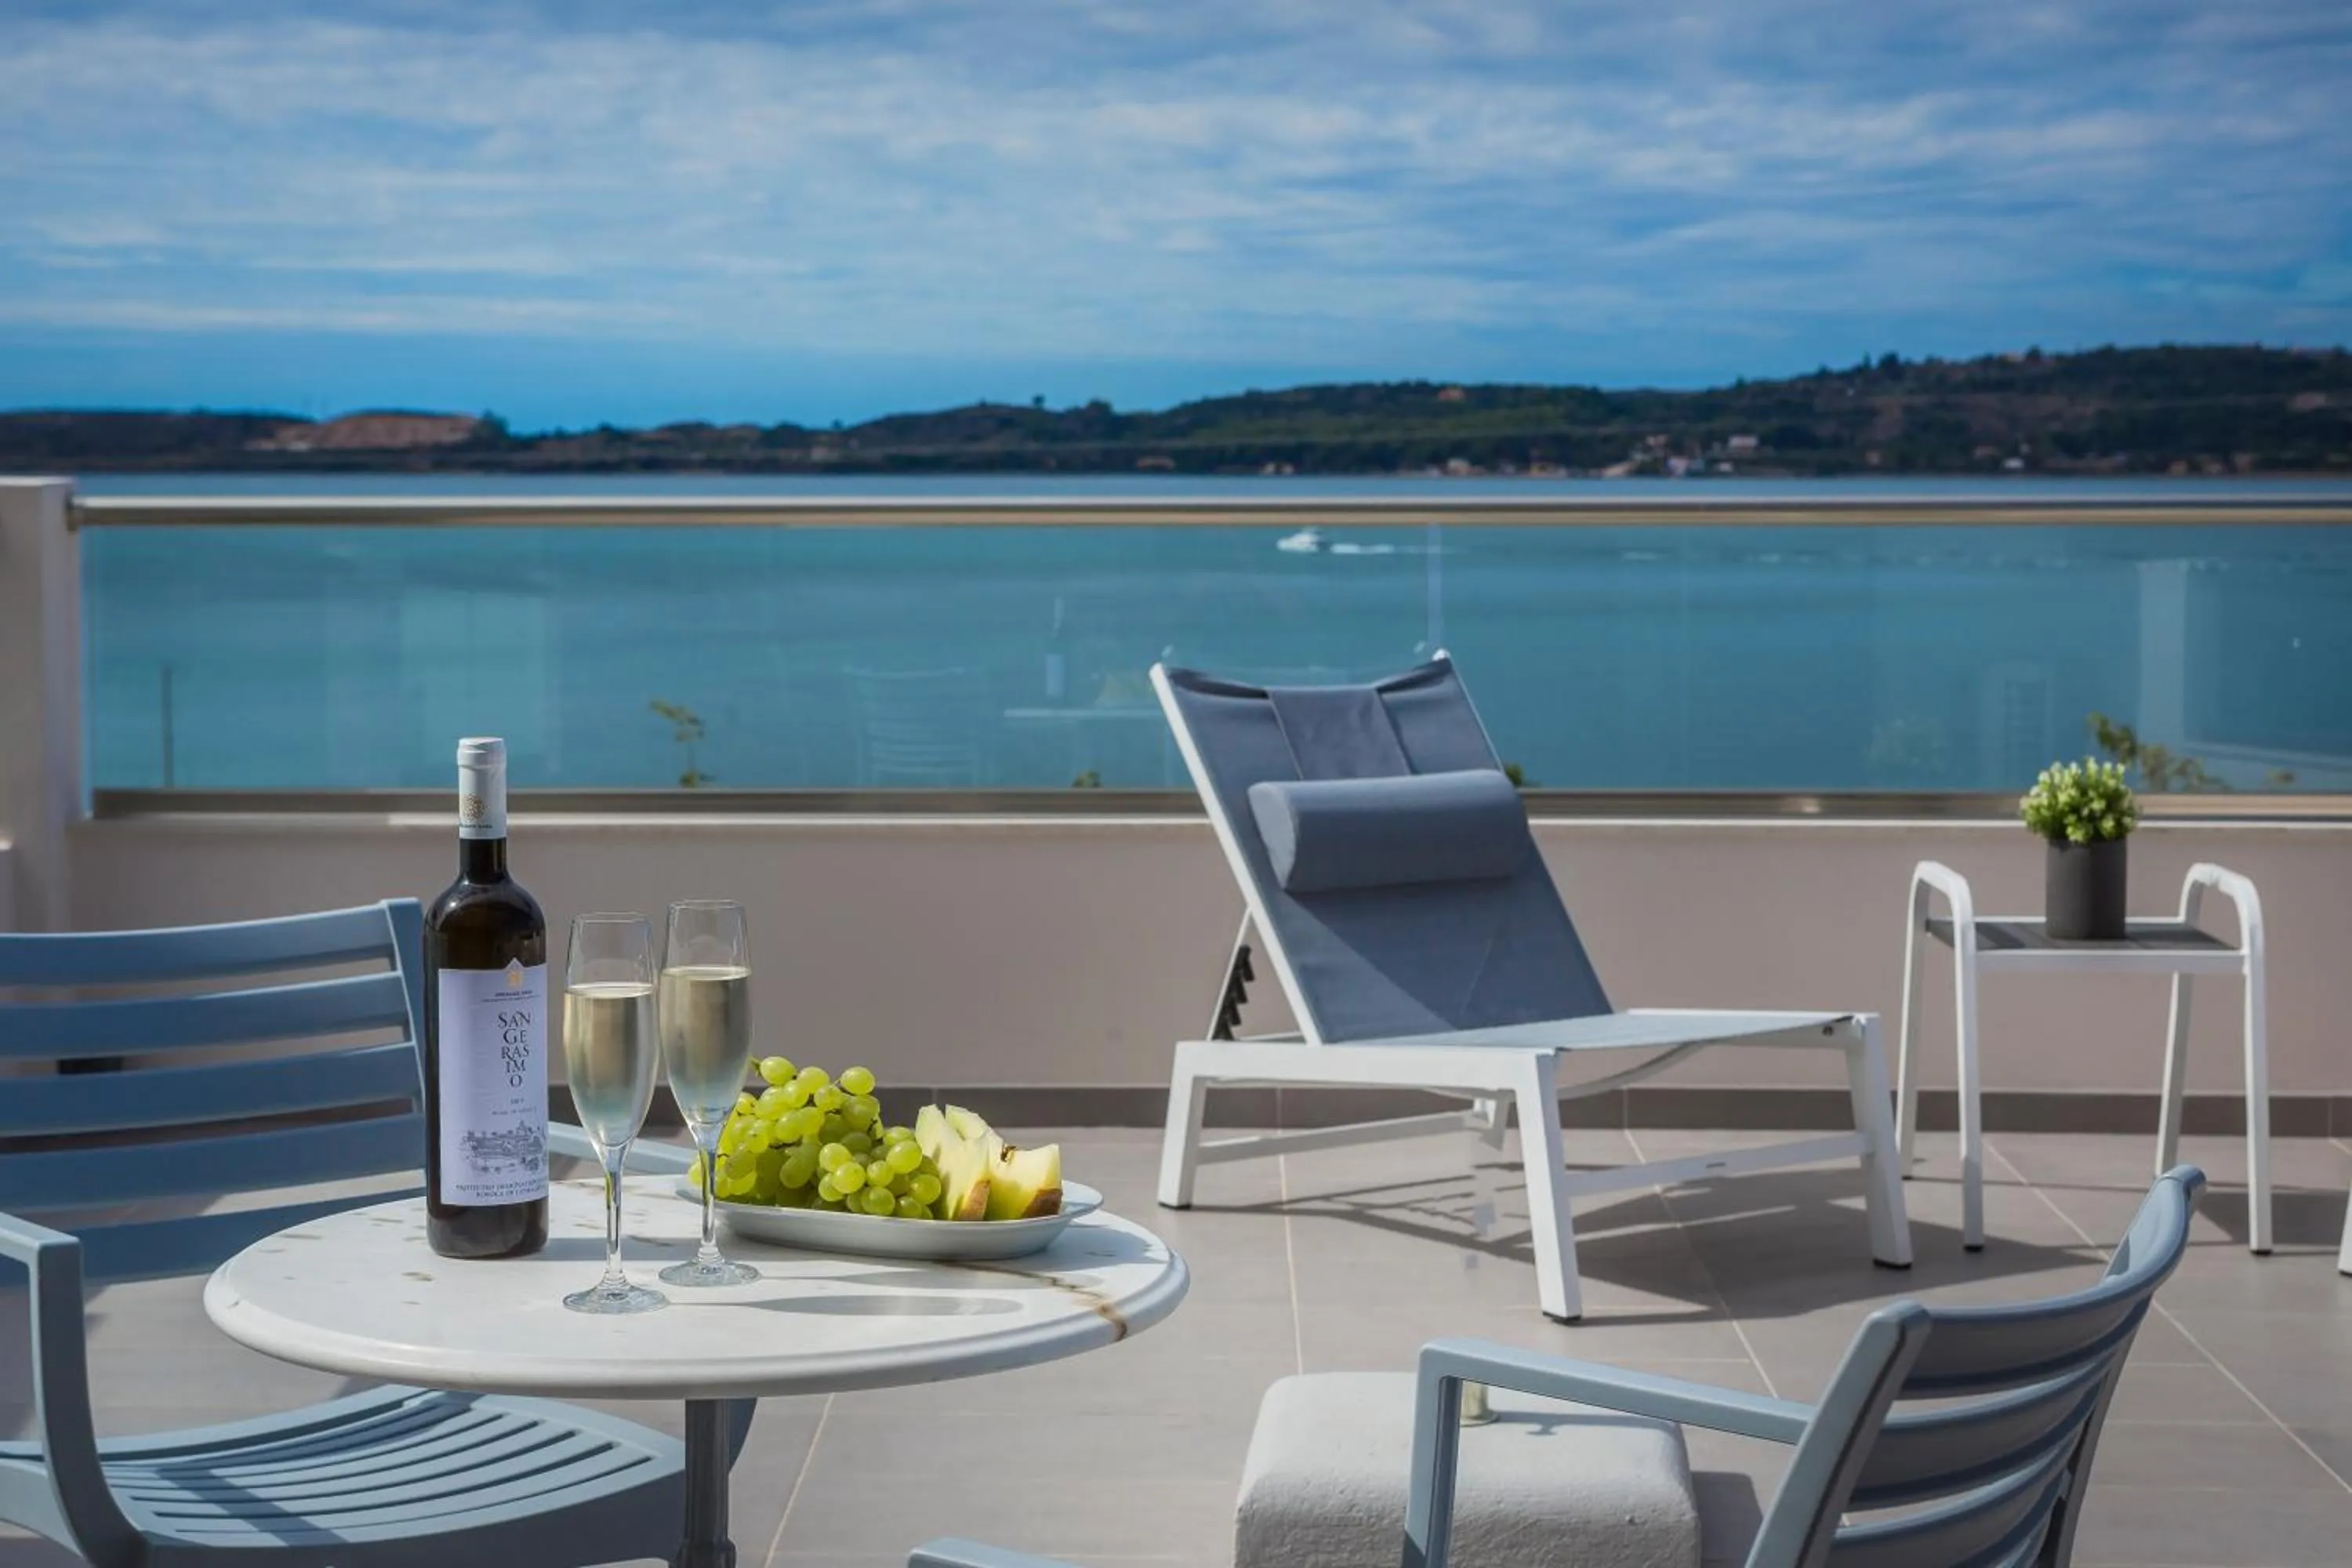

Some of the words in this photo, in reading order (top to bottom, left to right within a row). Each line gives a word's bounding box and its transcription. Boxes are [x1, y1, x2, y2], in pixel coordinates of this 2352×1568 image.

[497, 1011, 532, 1028] SAN
[503, 1029, 527, 1044] GE
[501, 1045, 530, 1060] RAS
[510, 1074, 522, 1087] O
